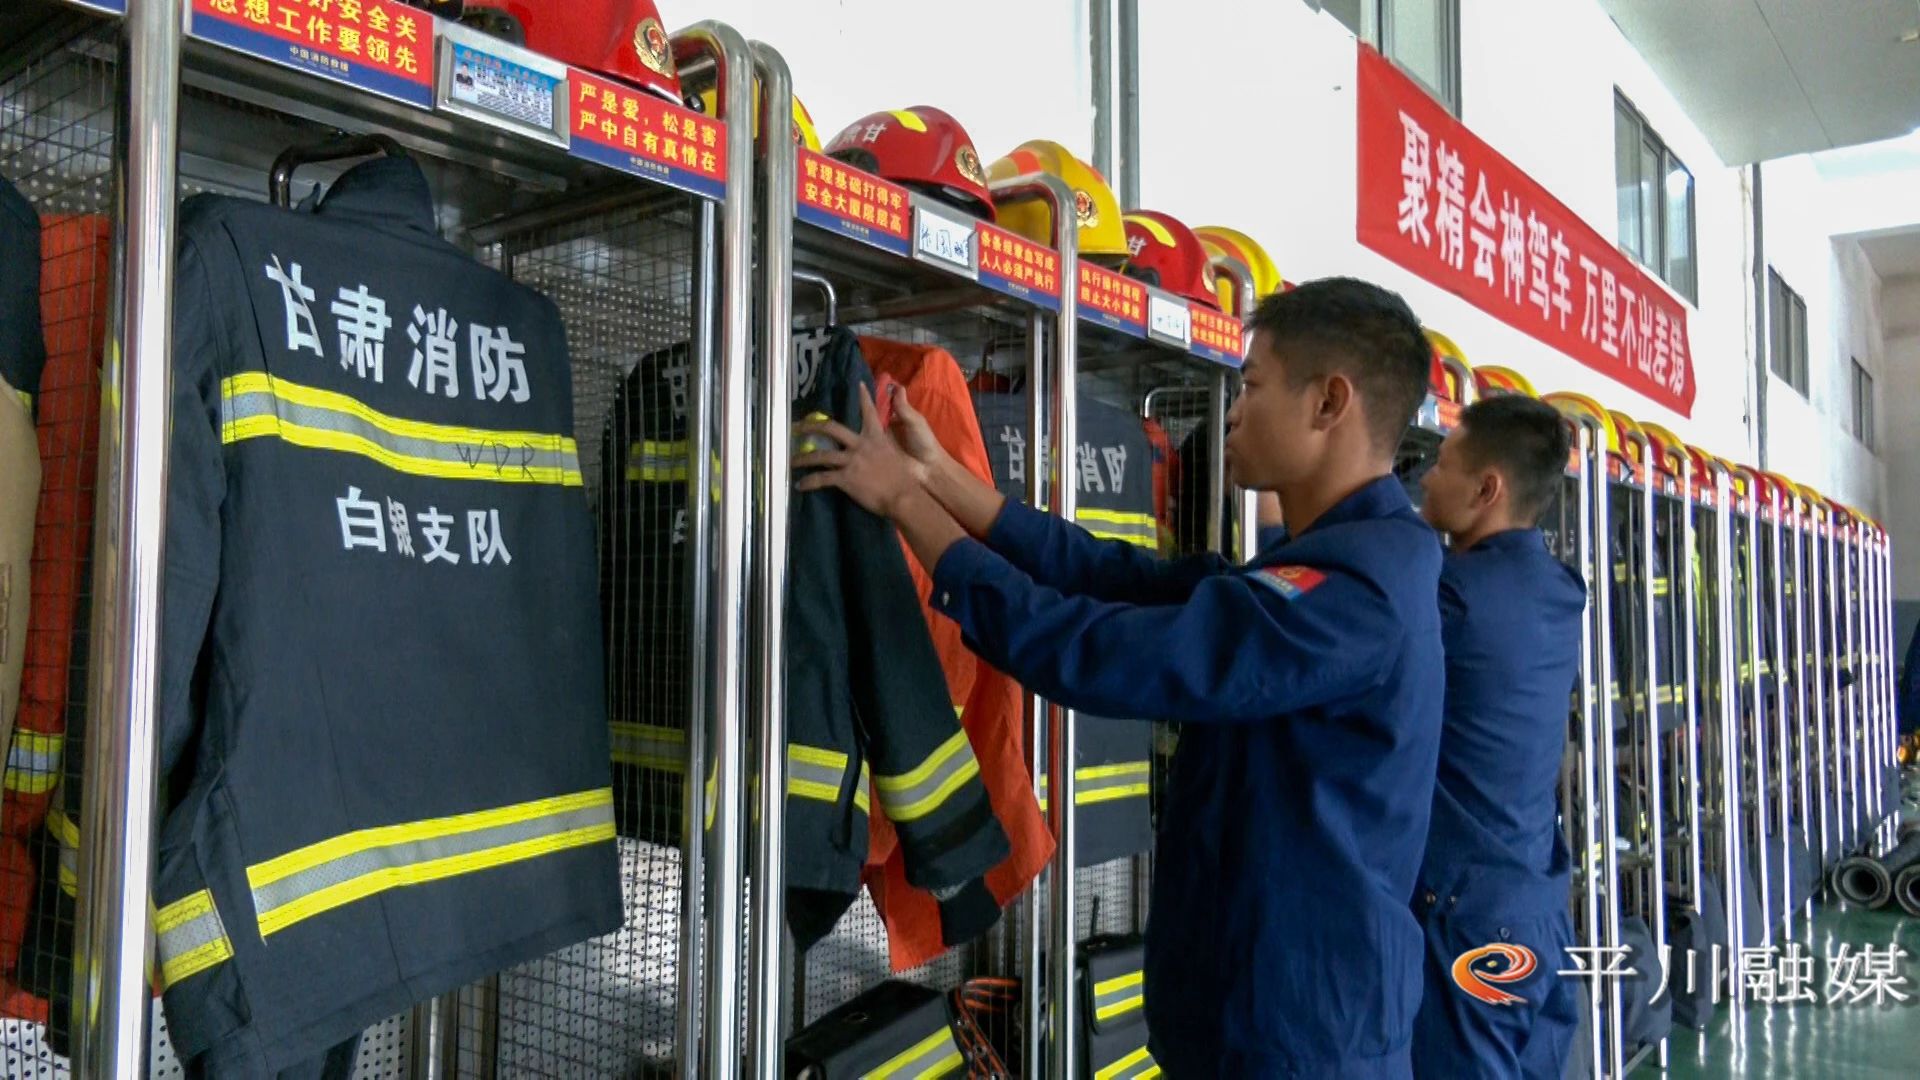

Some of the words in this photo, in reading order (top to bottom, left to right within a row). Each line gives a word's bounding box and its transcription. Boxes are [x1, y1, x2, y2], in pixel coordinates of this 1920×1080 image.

[578, 110, 718, 174] 严中自有真情在
[804, 157, 903, 210] 管理基础打得牢
[1397, 108, 1573, 332] 聚精会神驾车
[1578, 253, 1687, 397] 万里不出差错
[265, 253, 532, 402] 甘肃消防
